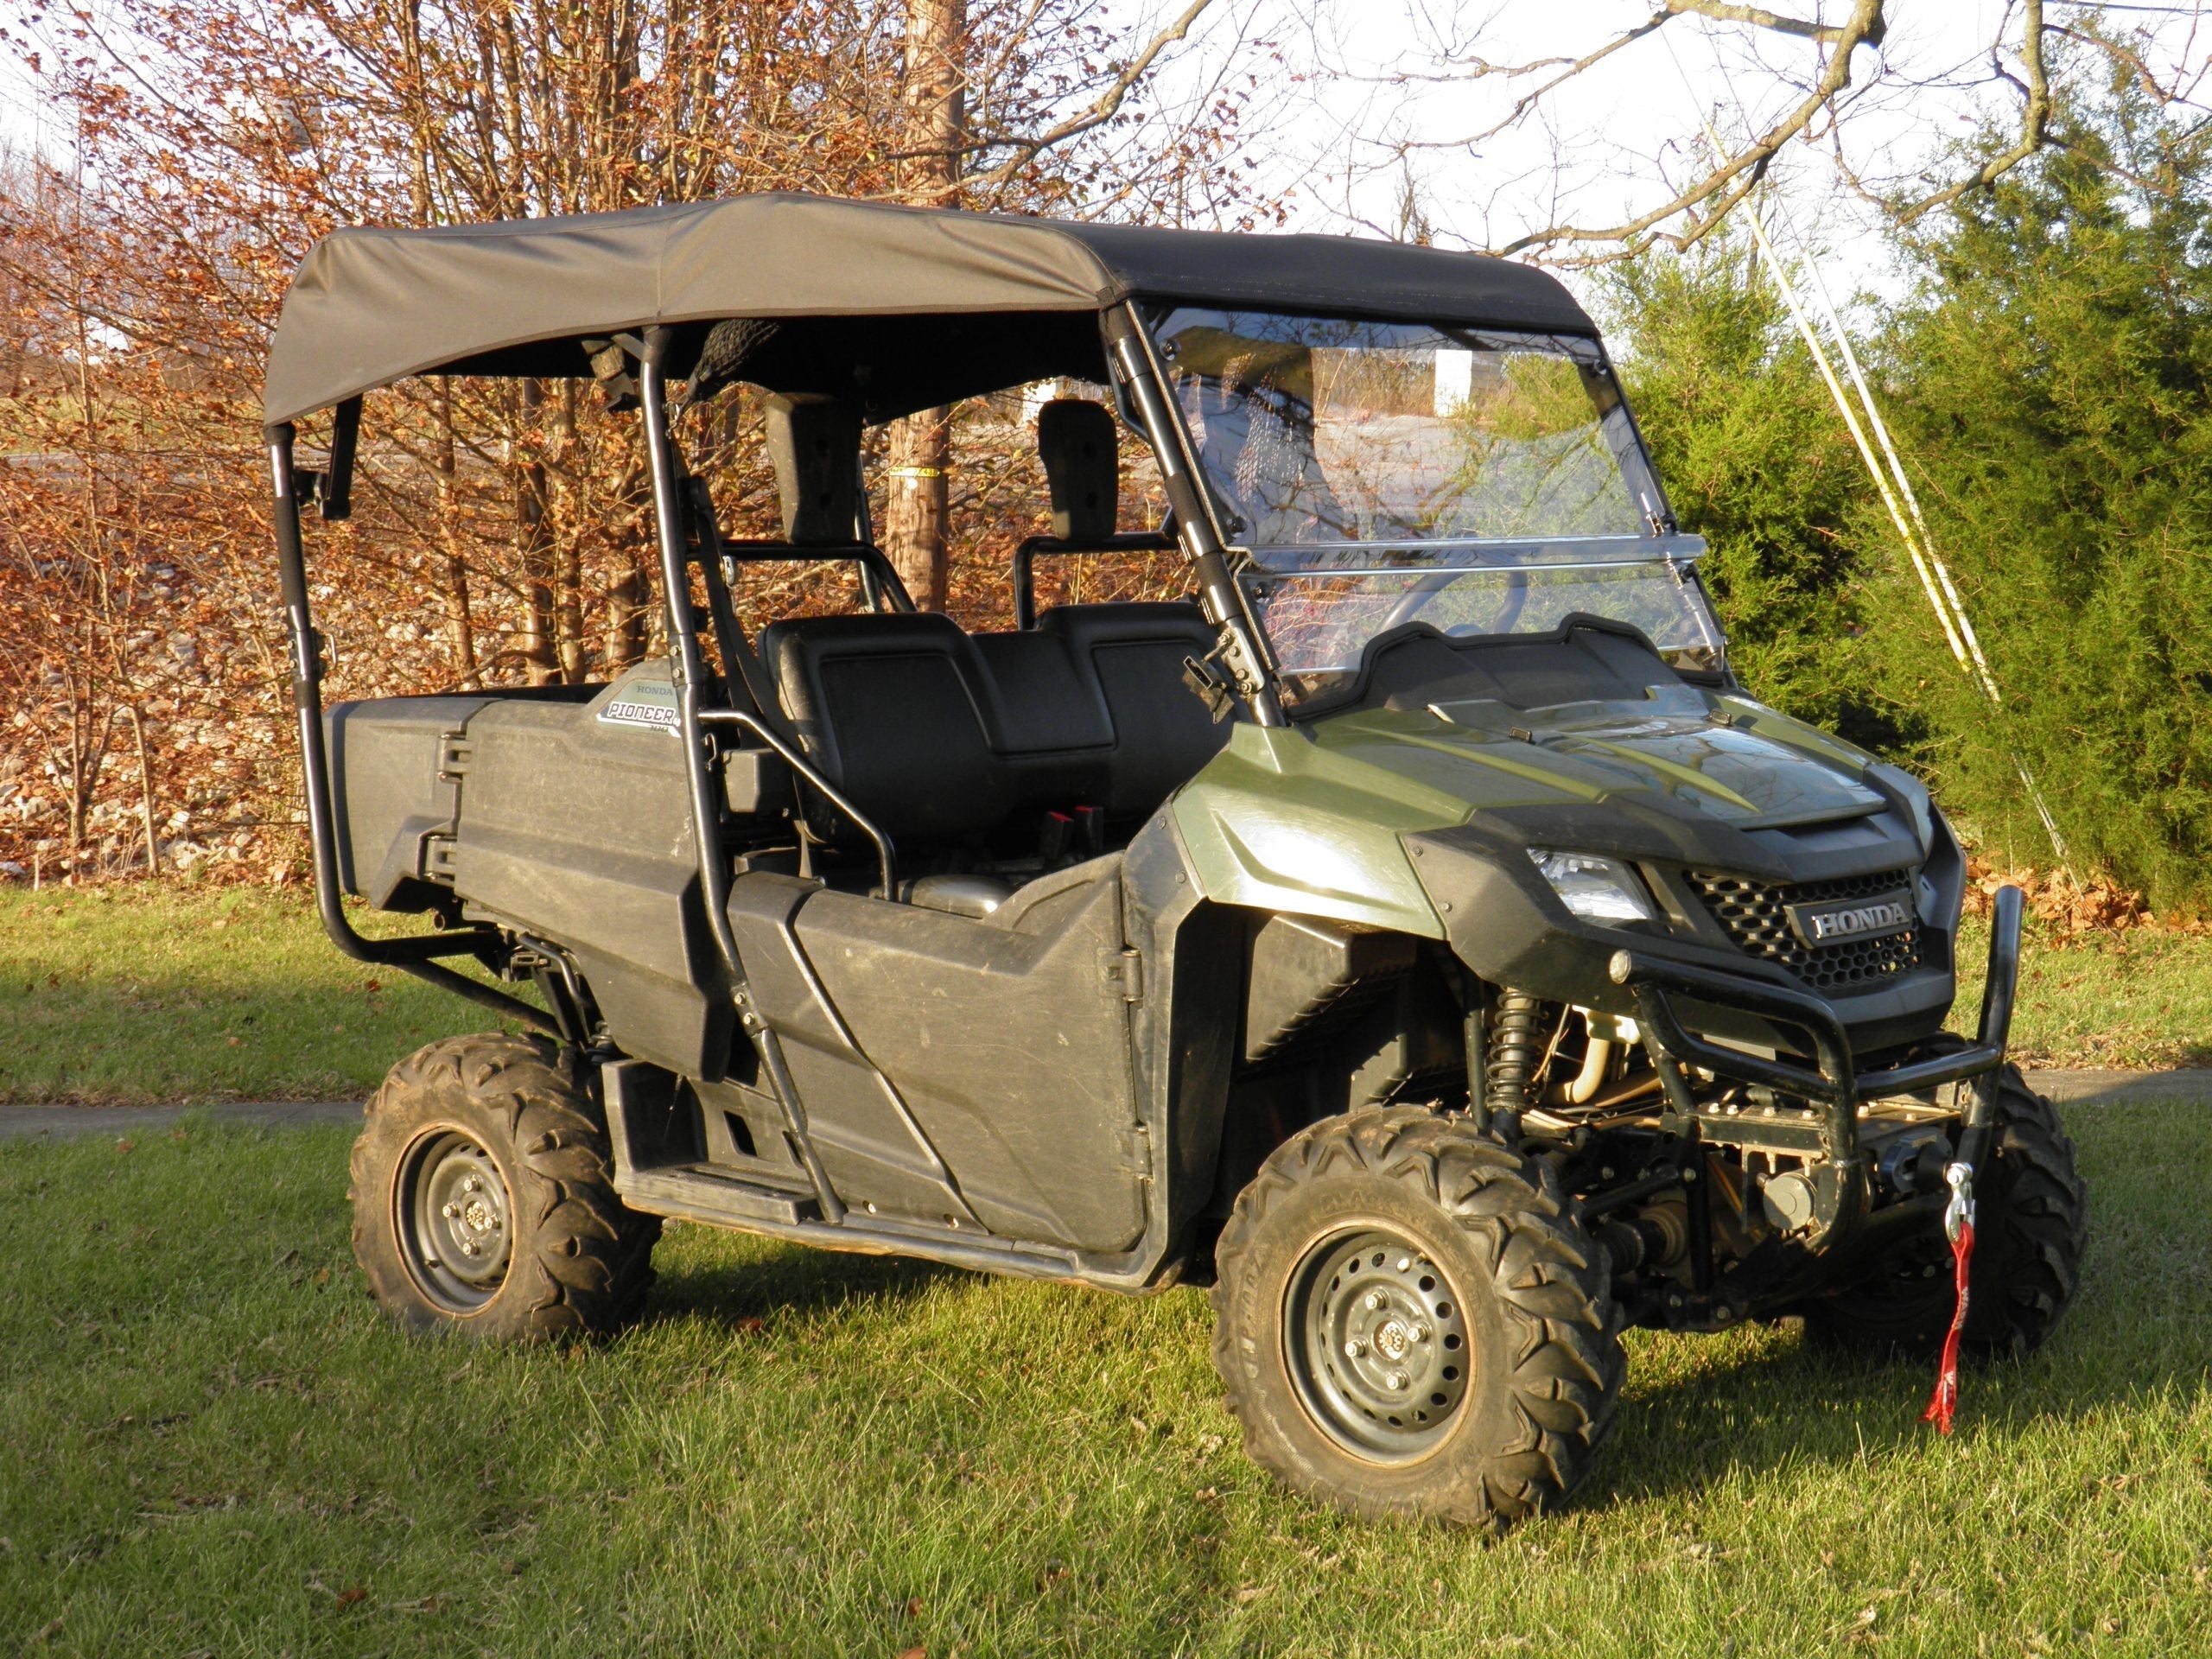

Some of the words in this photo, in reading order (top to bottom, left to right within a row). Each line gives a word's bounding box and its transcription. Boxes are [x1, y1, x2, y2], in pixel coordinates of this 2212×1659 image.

[637, 685, 674, 696] HONDA
[607, 702, 675, 724] PIONEER
[1812, 902, 1910, 939] HONDA
